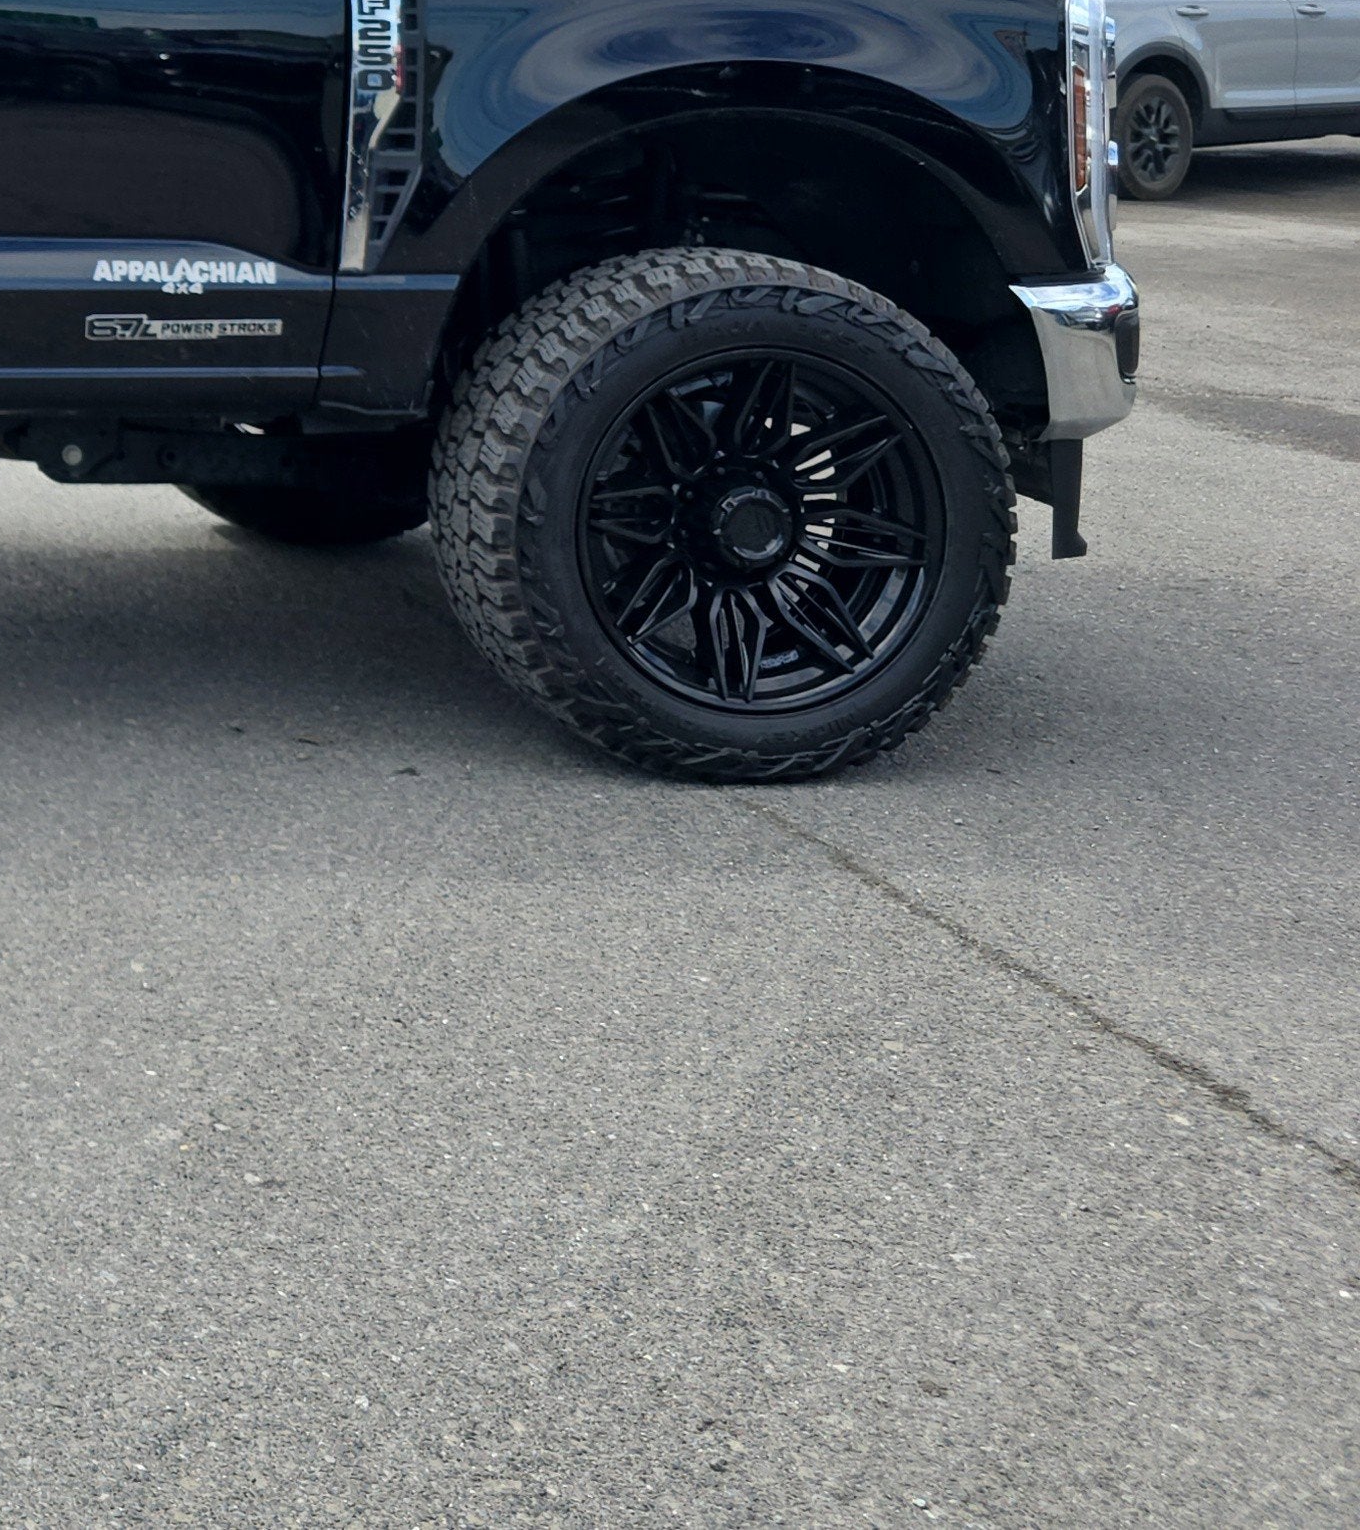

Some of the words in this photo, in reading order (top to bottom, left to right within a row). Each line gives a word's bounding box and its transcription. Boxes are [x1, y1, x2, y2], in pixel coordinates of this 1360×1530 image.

[92, 257, 278, 285] APPALACHIAN
[85, 316, 158, 340] 6.7L
[160, 321, 213, 335] POWER
[217, 321, 278, 335] STROKE
